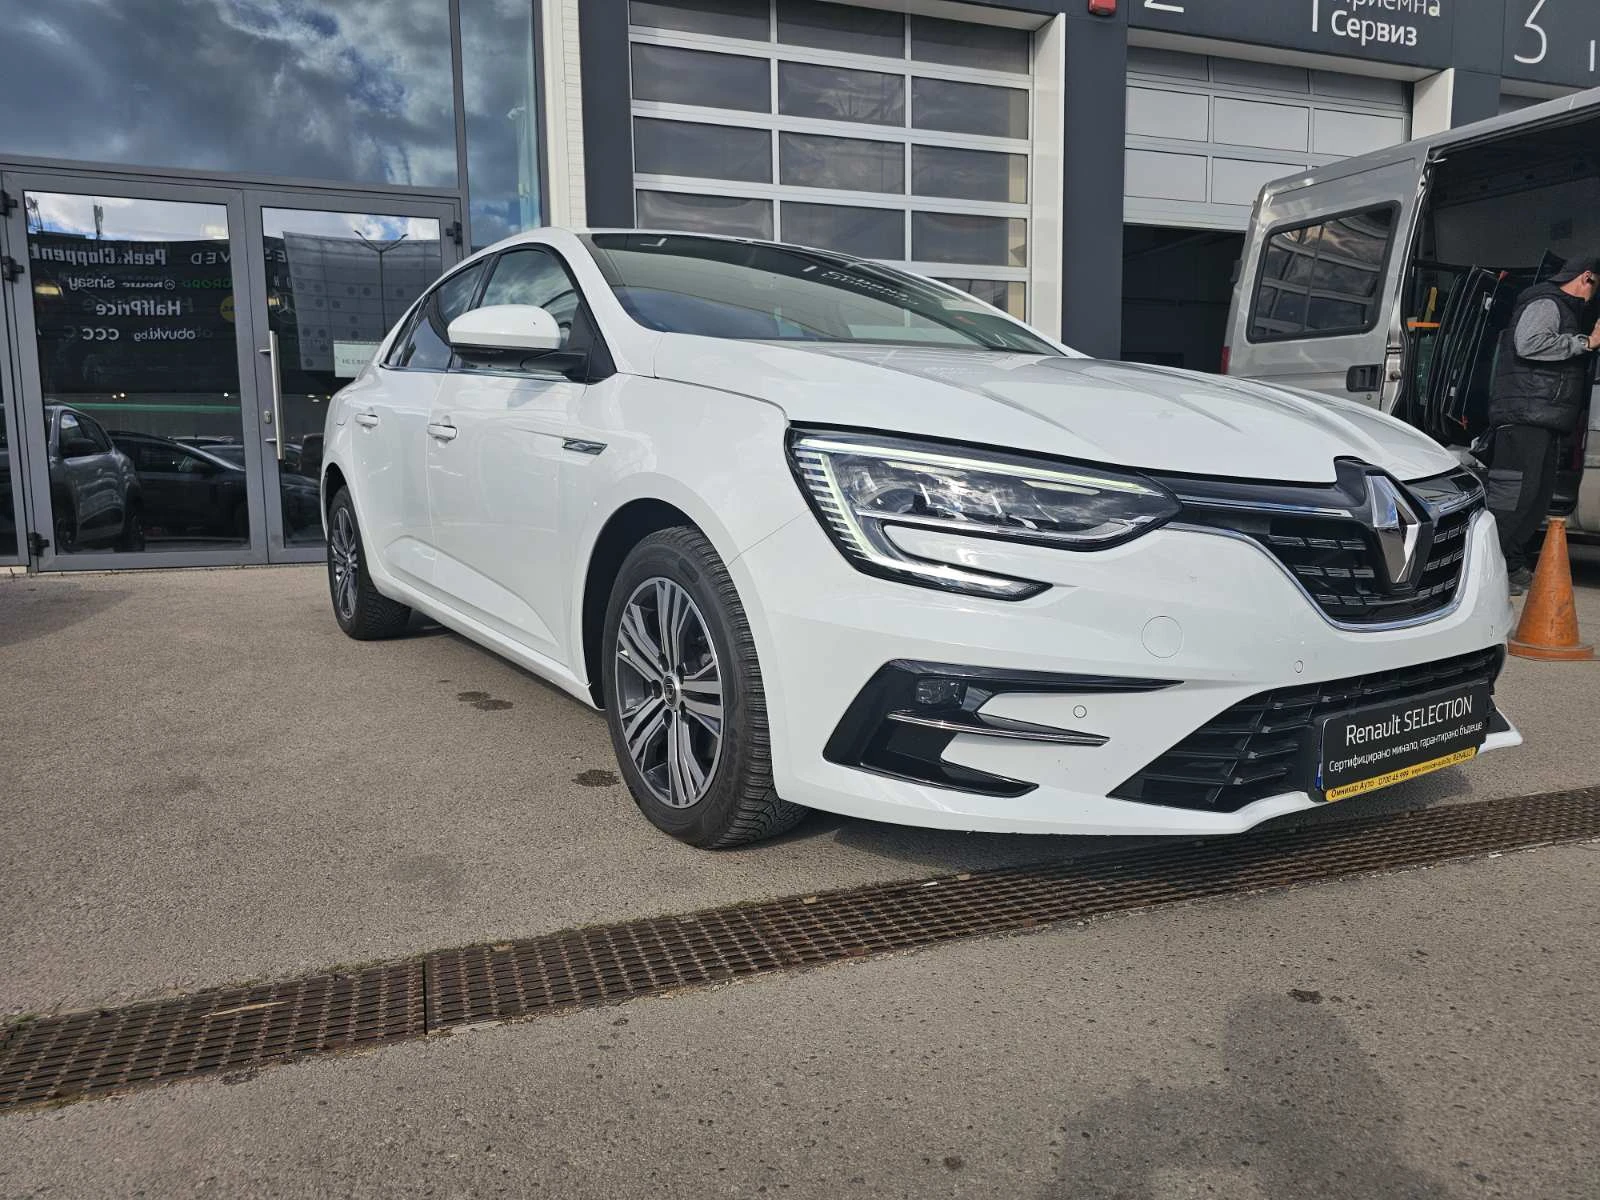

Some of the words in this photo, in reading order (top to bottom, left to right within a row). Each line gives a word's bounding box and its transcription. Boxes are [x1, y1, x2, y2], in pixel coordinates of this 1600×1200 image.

[1331, 9, 1418, 47] Сервиз
[1346, 713, 1401, 746] Renault
[1403, 694, 1473, 732] SELECTION
[1329, 750, 1392, 773] Сертифицирано
[1391, 741, 1420, 757] минало,
[1419, 730, 1459, 749] гарантирано
[1459, 721, 1483, 737] бъдеще
